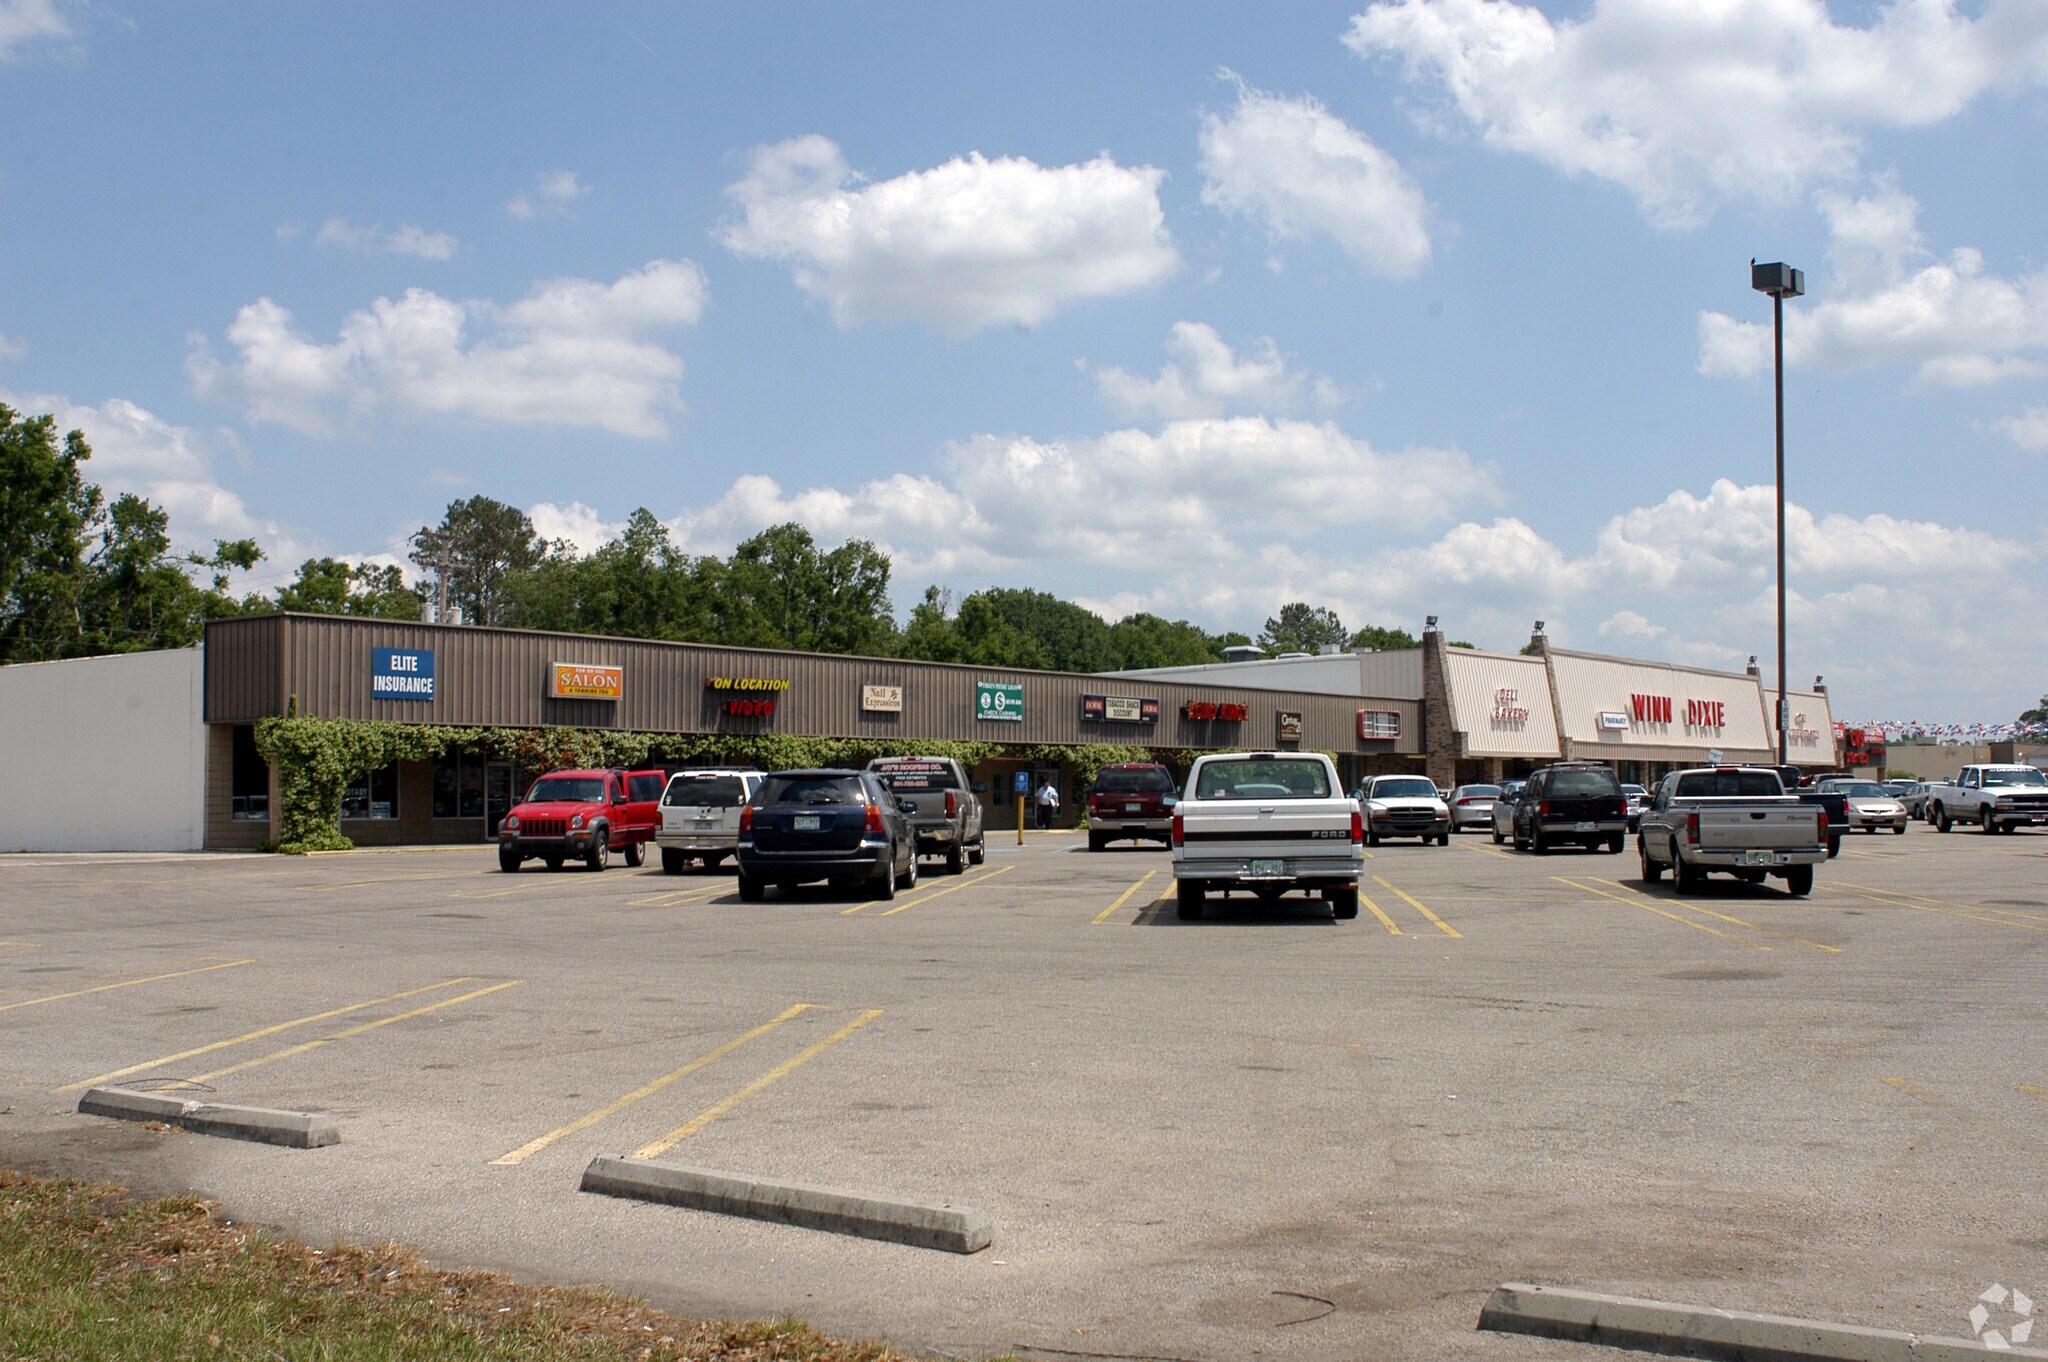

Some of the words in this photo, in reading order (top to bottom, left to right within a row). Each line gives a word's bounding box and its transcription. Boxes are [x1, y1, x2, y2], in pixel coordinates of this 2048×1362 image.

[391, 655, 418, 671] ELITE
[374, 675, 433, 693] INSURANCE
[561, 672, 618, 688] SALON
[714, 678, 732, 689] ON
[733, 678, 790, 690] LOCATION
[871, 687, 886, 698] Nail
[1500, 688, 1517, 702] DELI
[865, 697, 900, 708] Expressions
[1085, 701, 1103, 710] DORAL
[1107, 700, 1125, 709] TOBACCO
[1126, 701, 1140, 709] SHACK
[729, 700, 775, 717] VIDEO
[1113, 709, 1133, 717] DISCOUNT
[1143, 705, 1158, 714] DORAL
[1495, 707, 1529, 721] BAKERY
[1631, 693, 1672, 723] WINN
[1687, 699, 1725, 727] DIXIE
[343, 787, 368, 796] OTARY
[1311, 830, 1346, 839] FORD
